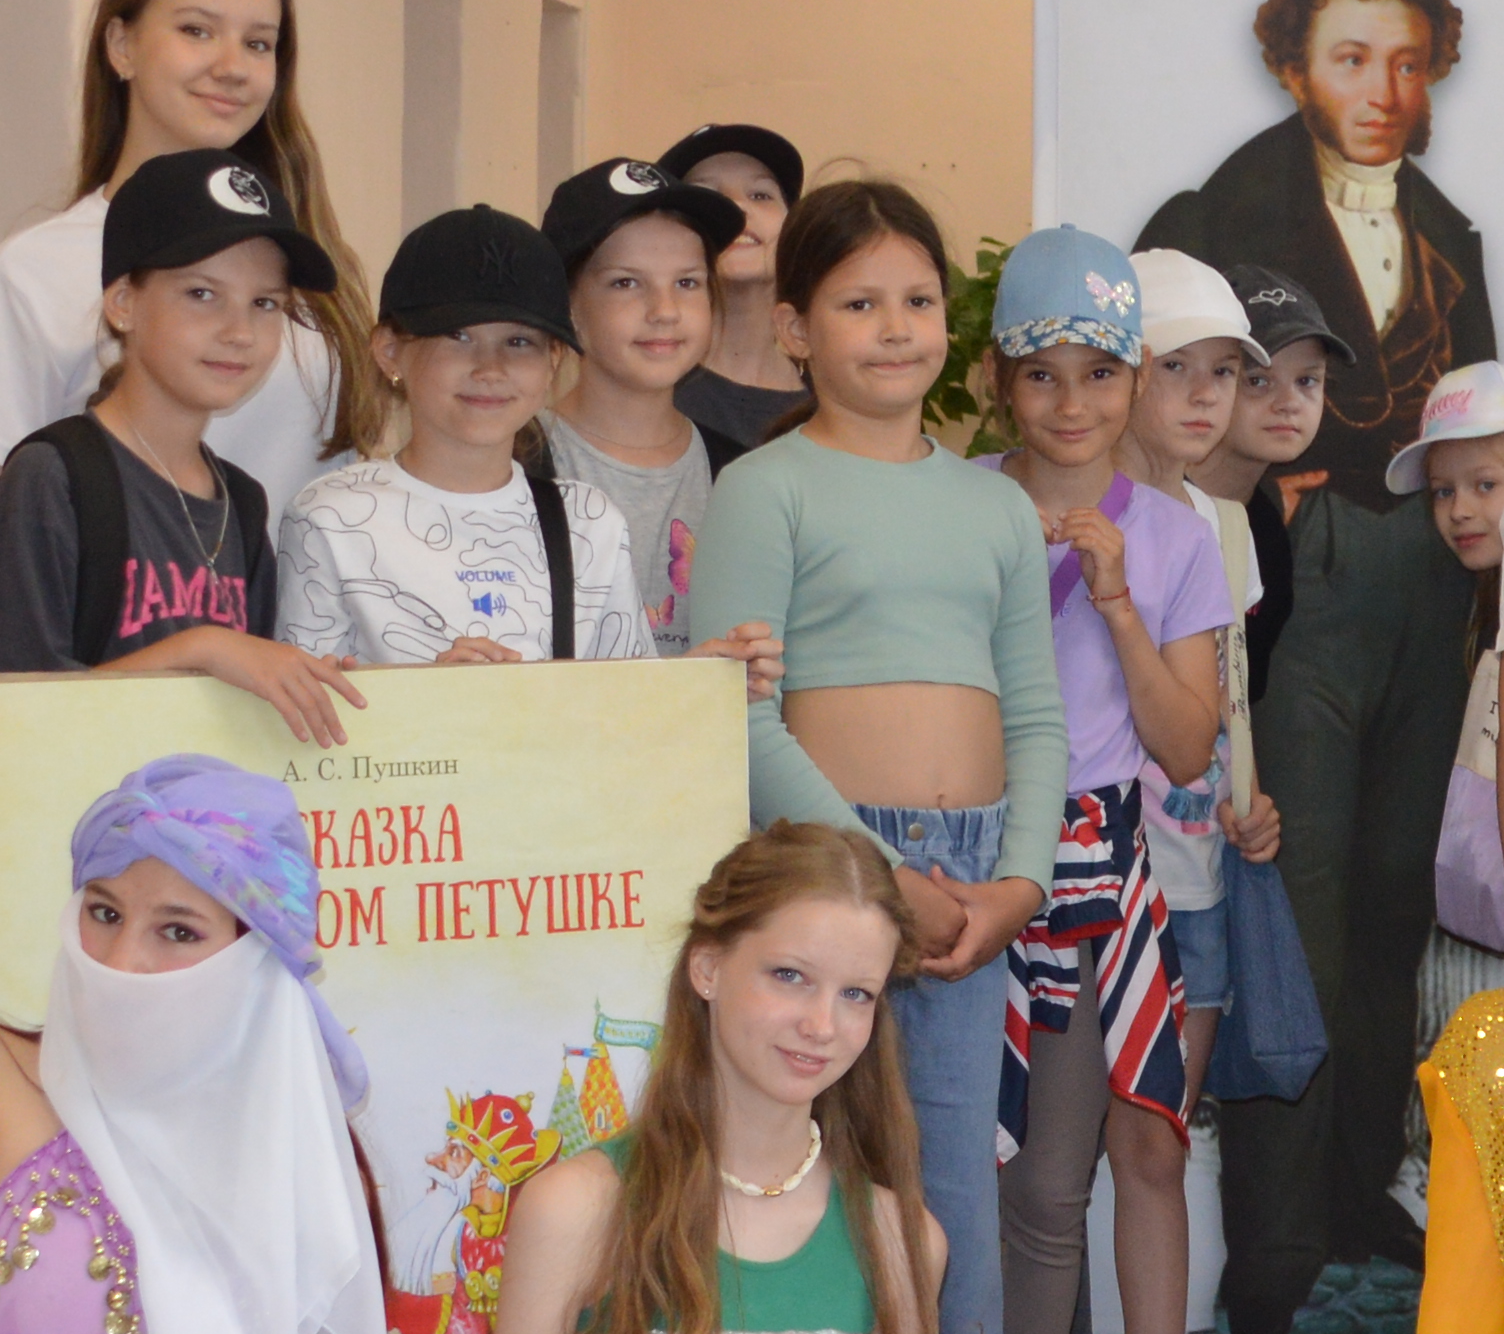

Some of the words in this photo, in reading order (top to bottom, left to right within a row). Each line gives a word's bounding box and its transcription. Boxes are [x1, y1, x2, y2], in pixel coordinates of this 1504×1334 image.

[455, 570, 516, 583] VOLUME
[282, 760, 307, 783] А.
[317, 757, 342, 781] С.
[351, 756, 460, 783] Пушкин
[299, 803, 463, 869] КАЗКА
[416, 870, 645, 942] ПЕТУШКЕ
